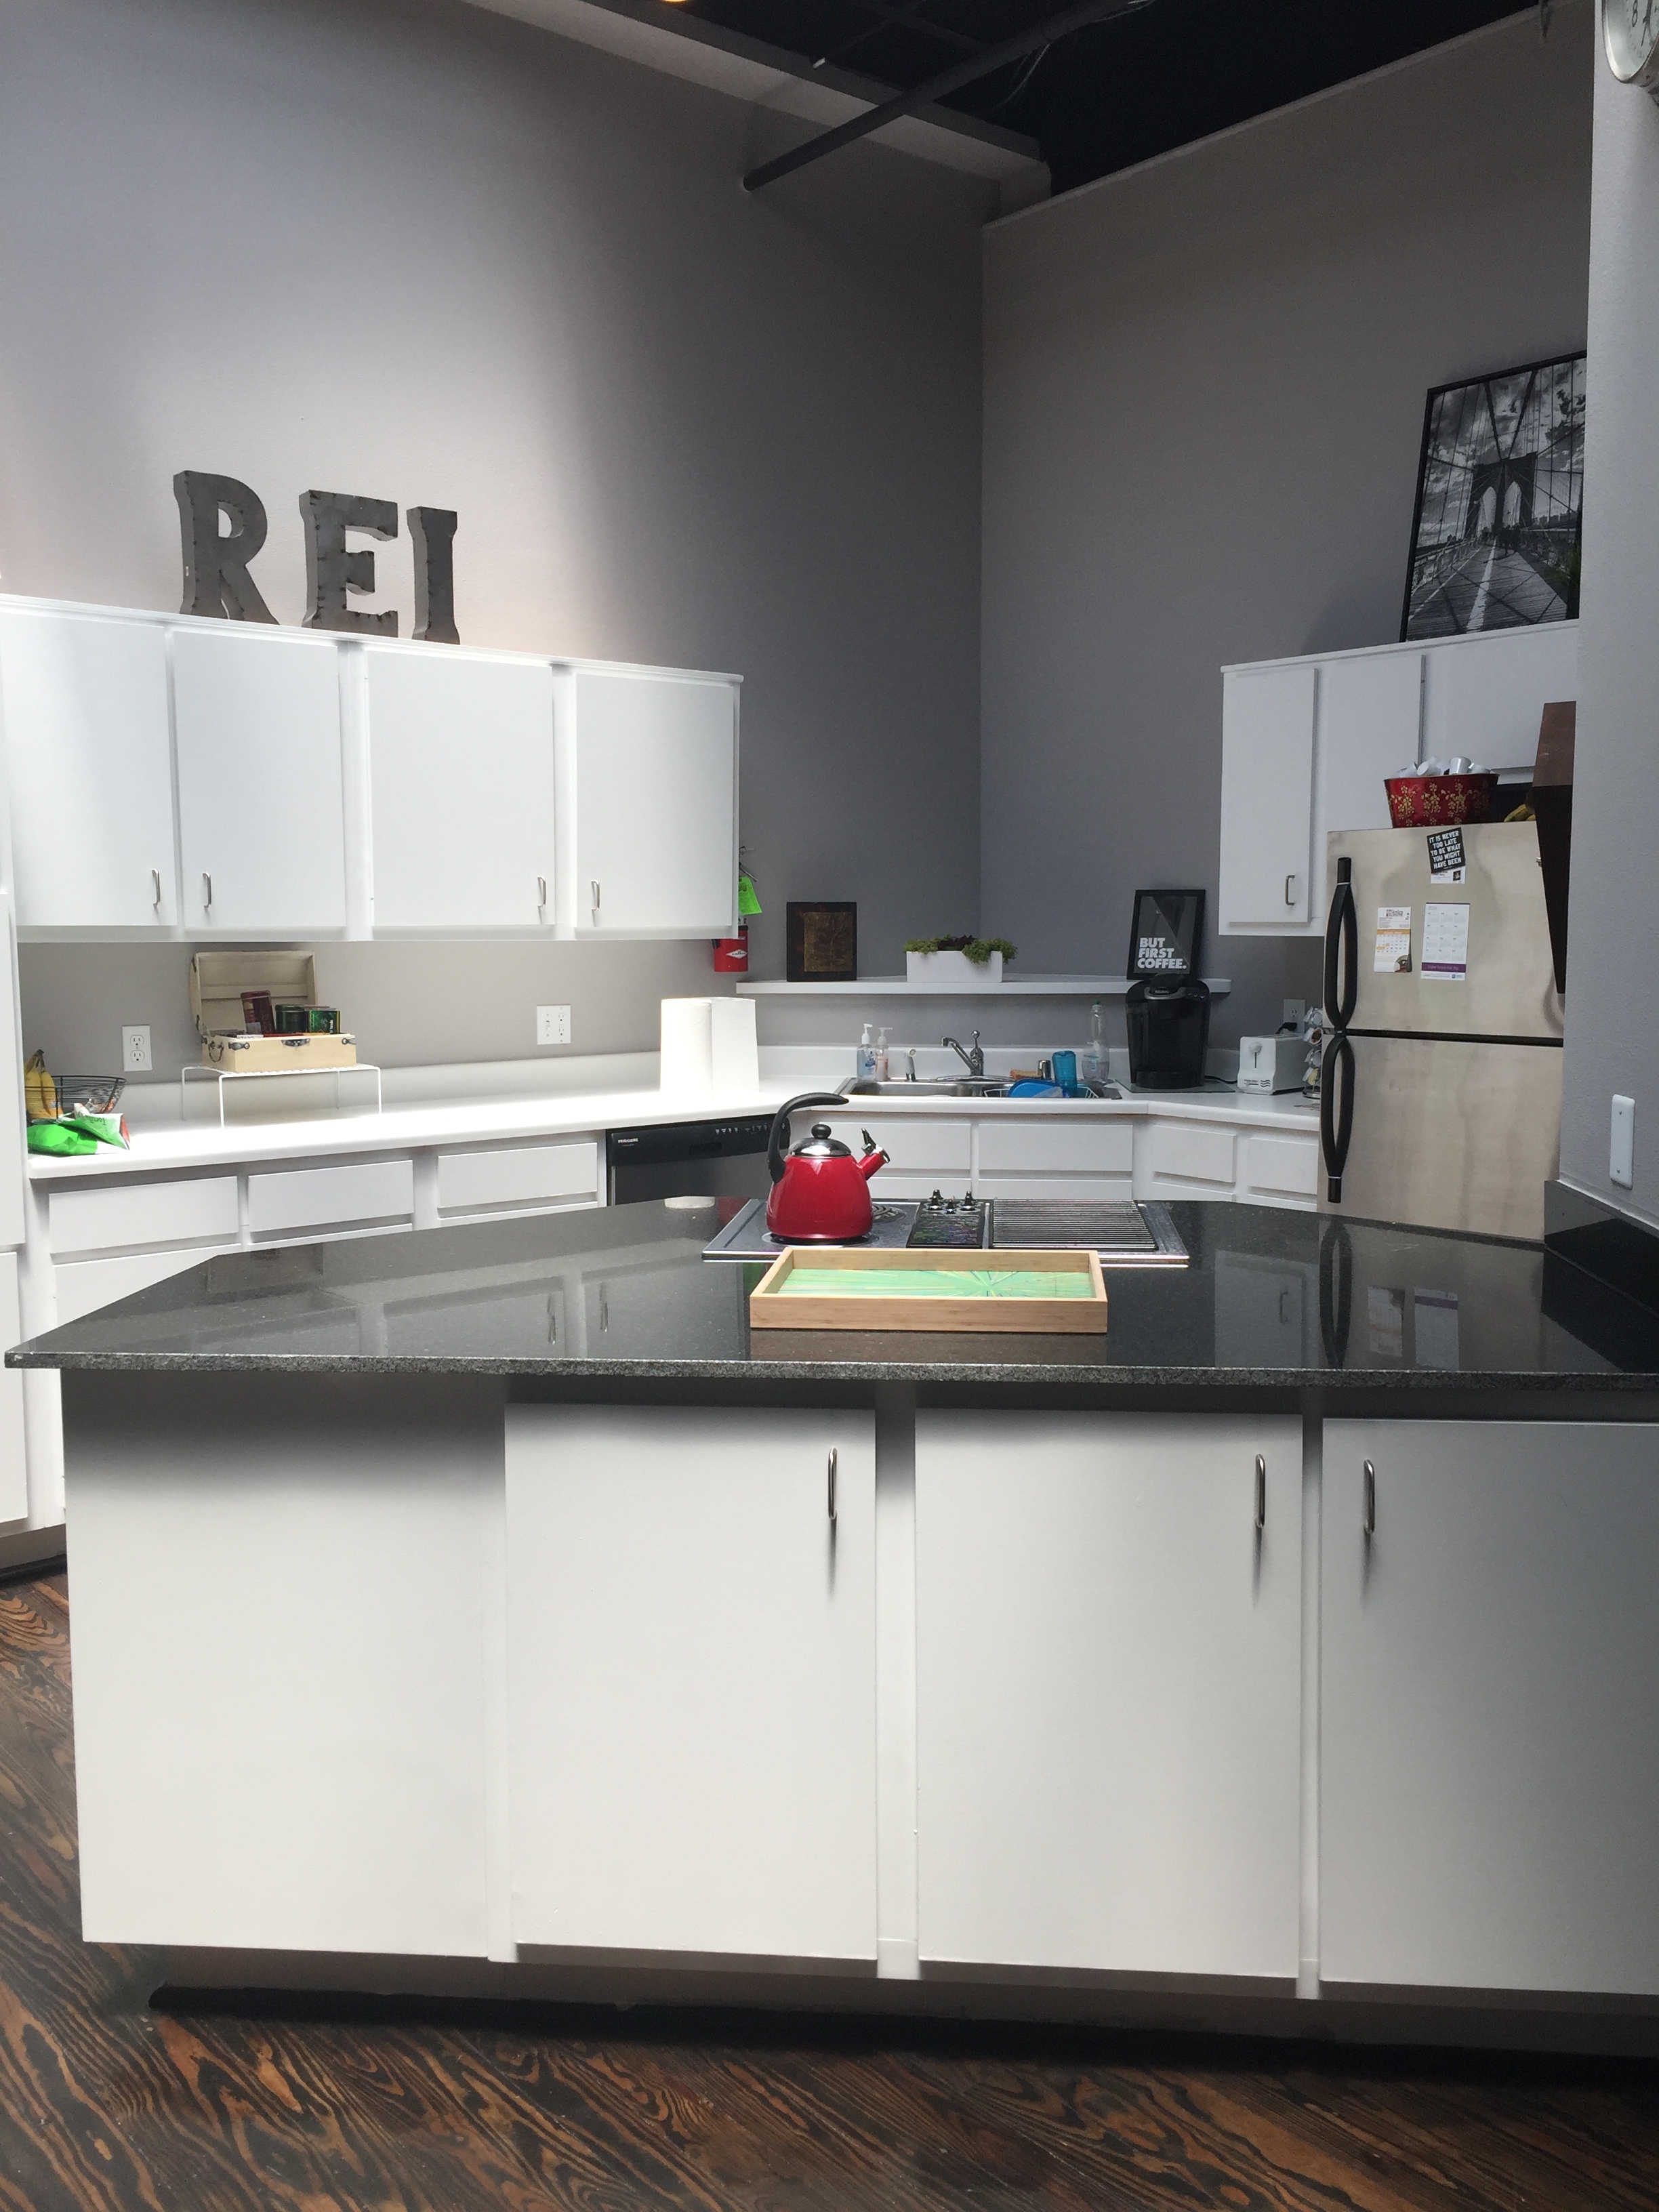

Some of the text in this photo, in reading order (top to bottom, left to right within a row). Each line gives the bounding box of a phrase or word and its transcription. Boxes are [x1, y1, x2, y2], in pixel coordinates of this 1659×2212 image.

[173, 470, 461, 645] REI
[1442, 830, 1459, 840] NEVER
[1433, 838, 1458, 849] TOO LATE
[1446, 843, 1461, 852] WHAT
[1433, 850, 1460, 863] YOU MIGHT
[1433, 857, 1462, 869] HAVE BEEN
[1139, 937, 1166, 948] BUT
[1138, 948, 1174, 958] FIRST
[1137, 958, 1187, 969] COFFEE.
